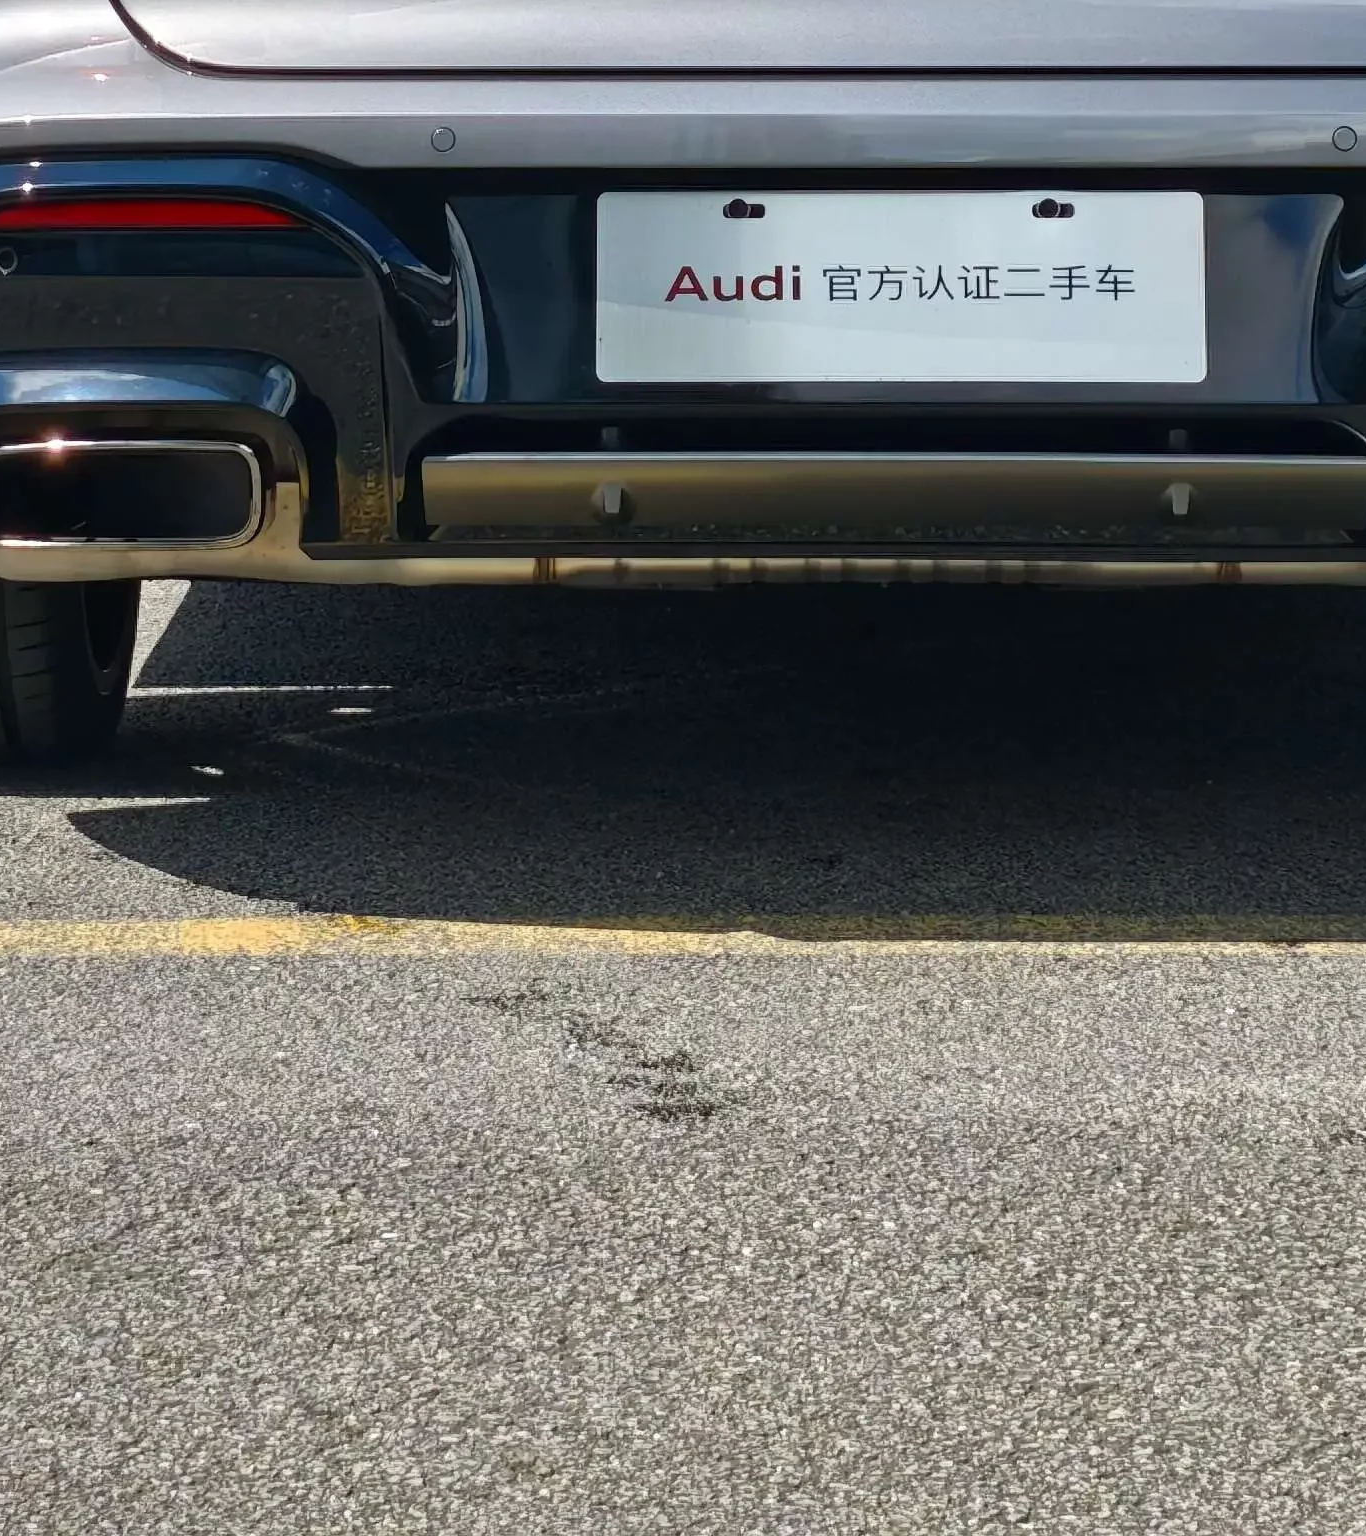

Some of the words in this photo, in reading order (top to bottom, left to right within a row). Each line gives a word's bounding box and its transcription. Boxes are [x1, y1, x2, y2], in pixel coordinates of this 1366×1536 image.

[664, 264, 802, 302] Audi
[822, 263, 1137, 302] 官方认证二手车
